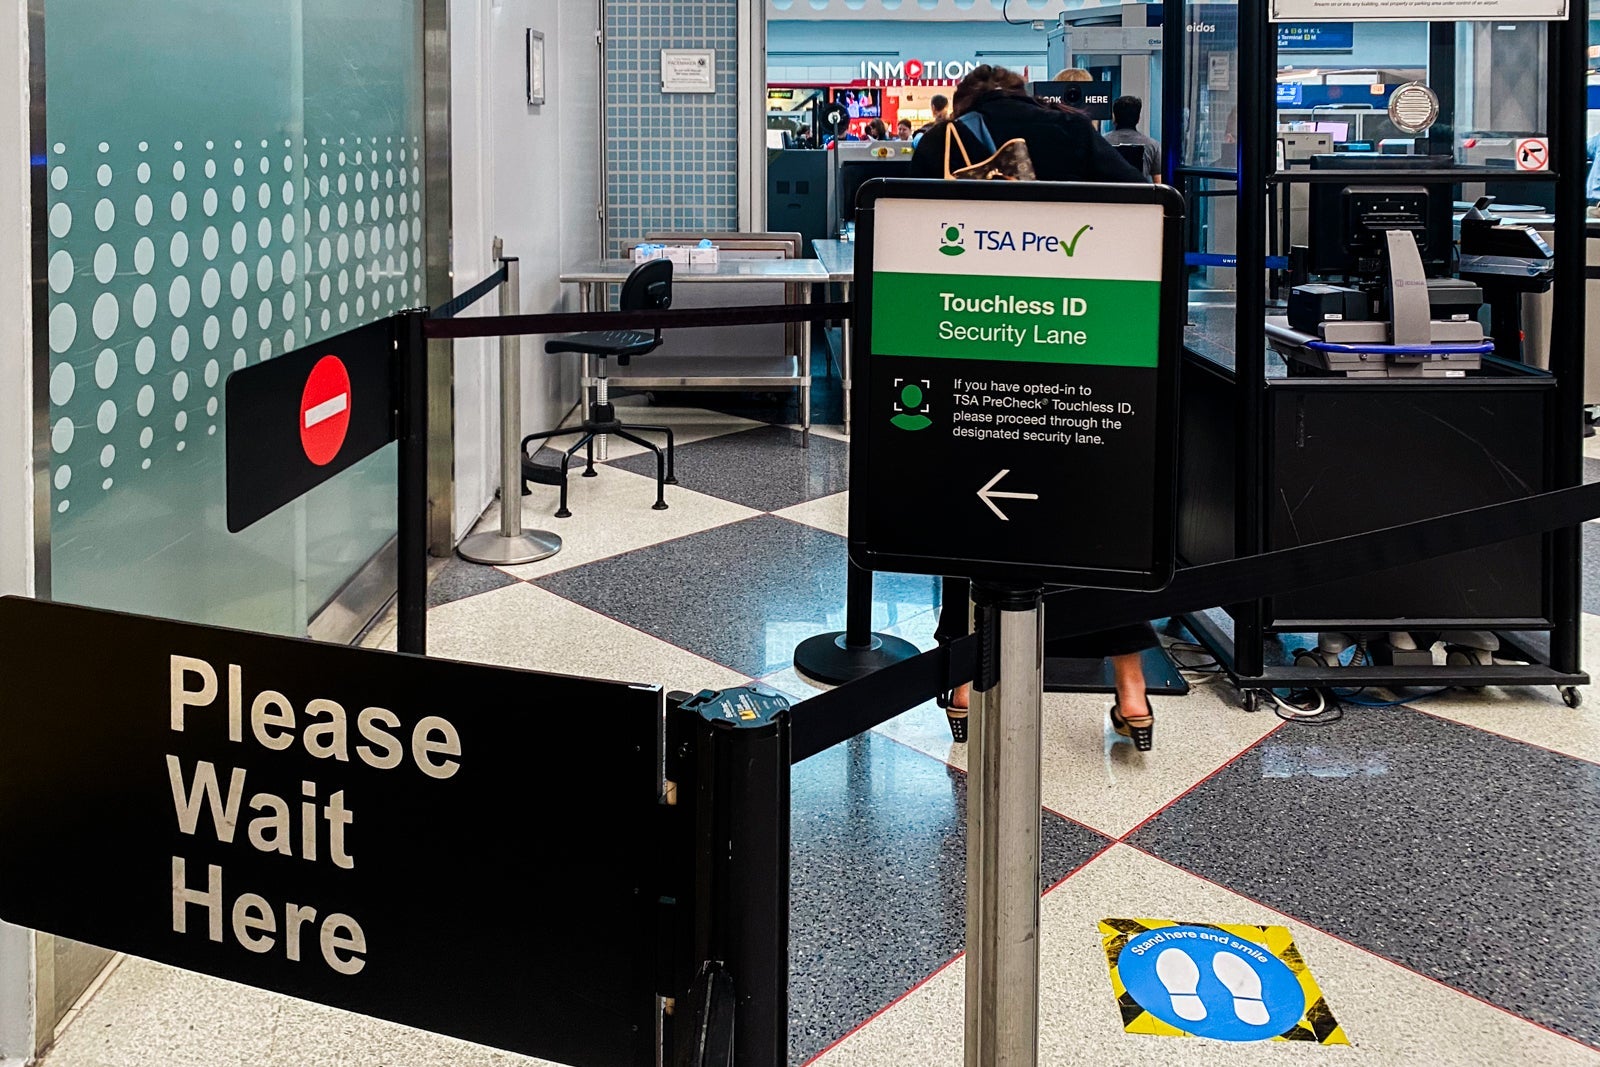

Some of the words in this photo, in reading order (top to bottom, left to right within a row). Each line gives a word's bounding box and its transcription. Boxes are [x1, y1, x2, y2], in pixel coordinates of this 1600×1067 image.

[1186, 22, 1215, 33] eidos
[1085, 95, 1108, 103] HERE
[974, 230, 1016, 251] TSA
[939, 292, 1055, 316] Touchless
[1062, 297, 1088, 316] ID
[938, 320, 1027, 347] Security
[1033, 324, 1087, 345] Lane
[954, 379, 962, 390] If
[965, 381, 987, 392] you
[990, 380, 1020, 393] have
[1023, 383, 1075, 395] opted-in
[1079, 385, 1092, 396] to
[953, 394, 979, 406] TSA
[1052, 399, 1114, 413] Touchless
[1117, 402, 1135, 415] ID,
[953, 411, 993, 423] please
[996, 414, 1046, 425] proceed
[1050, 416, 1098, 430] through
[1101, 418, 1122, 430] the
[952, 426, 1020, 440] designated
[1023, 431, 1072, 445] security
[1075, 432, 1105, 445] lane.
[169, 654, 463, 780] Please
[165, 753, 355, 870] Wait
[171, 855, 368, 976] Here
[1130, 933, 1165, 956] Stand
[1165, 930, 1197, 941] here
[1200, 931, 1230, 945] and
[1230, 940, 1269, 964] smile
